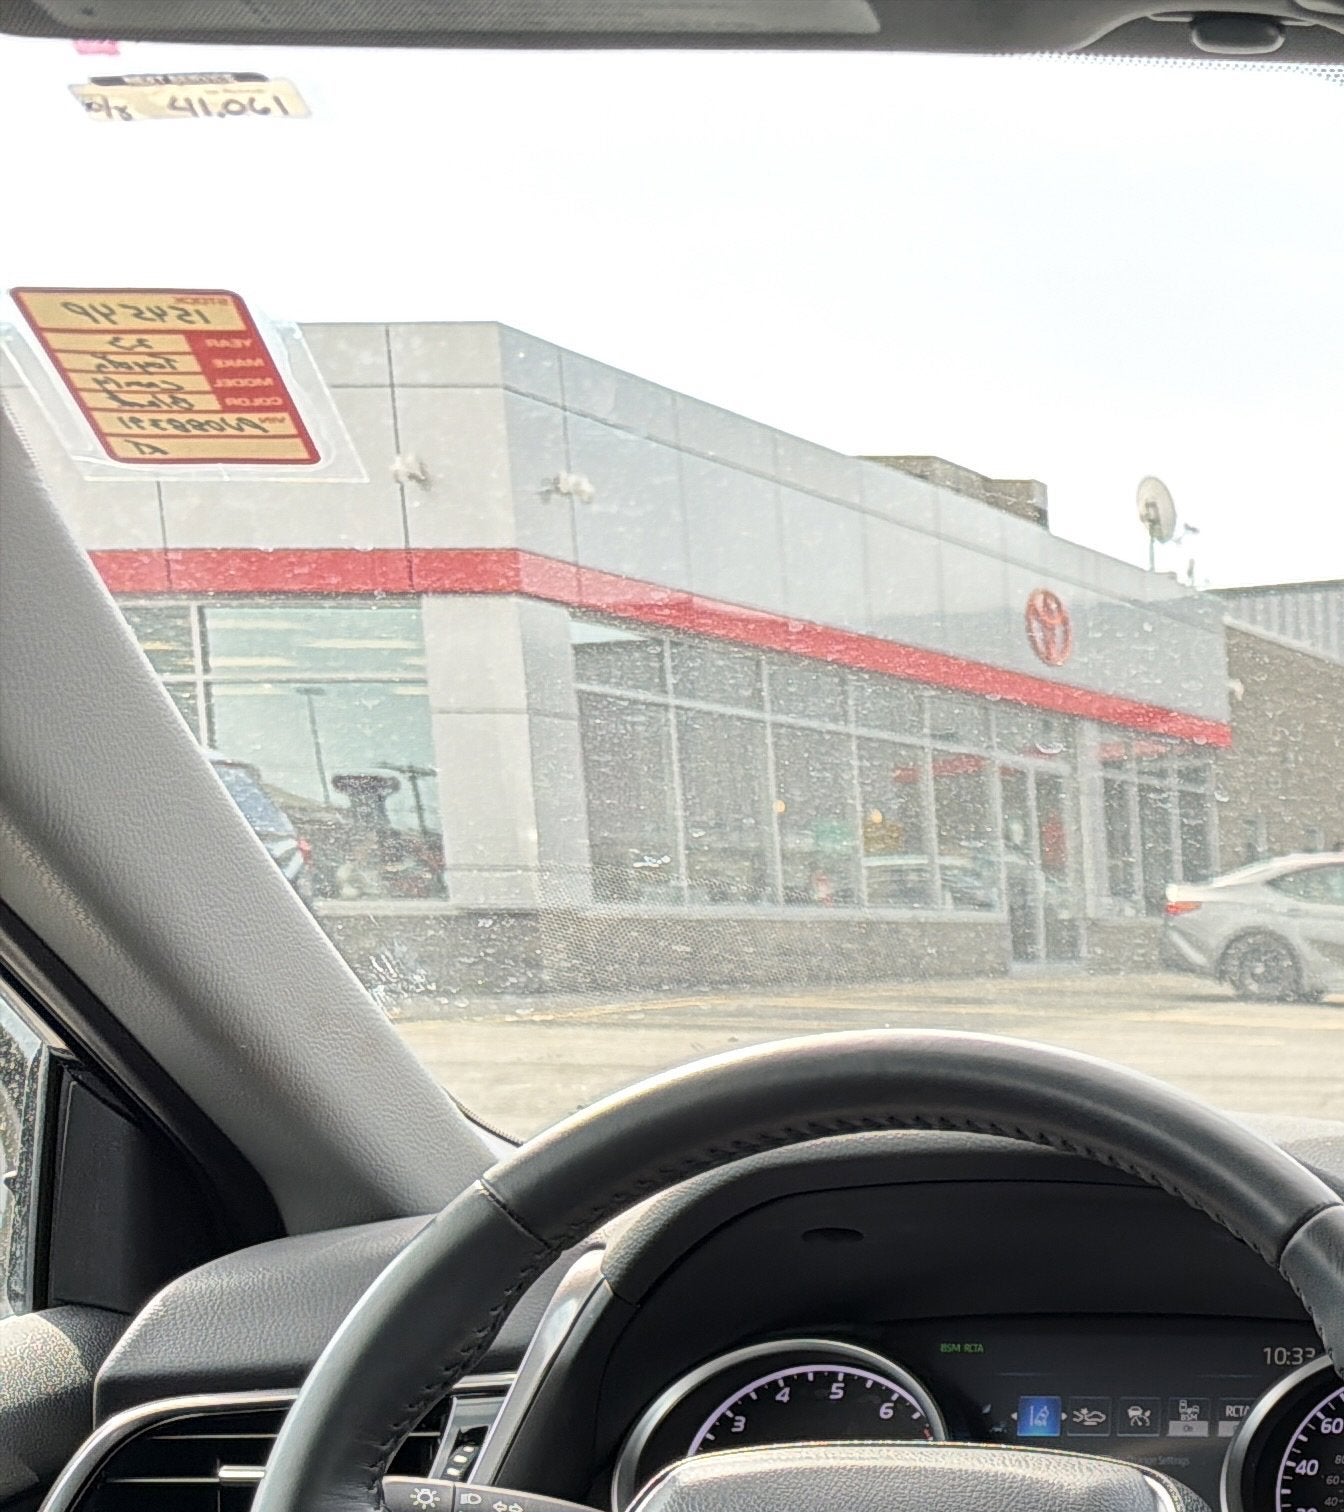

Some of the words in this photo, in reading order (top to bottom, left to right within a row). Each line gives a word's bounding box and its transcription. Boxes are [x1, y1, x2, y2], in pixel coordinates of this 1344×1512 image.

[940, 1343, 961, 1353] BSM
[963, 1343, 985, 1353] RCTA
[774, 1387, 790, 1403] 4
[828, 1383, 845, 1400] 5
[879, 1402, 895, 1420] 6
[730, 1416, 746, 1433] 3
[1320, 1417, 1344, 1434] 60
[1295, 1460, 1319, 1476] 40
[1326, 1476, 1340, 1485] 60
[1324, 1497, 1338, 1507] 40
